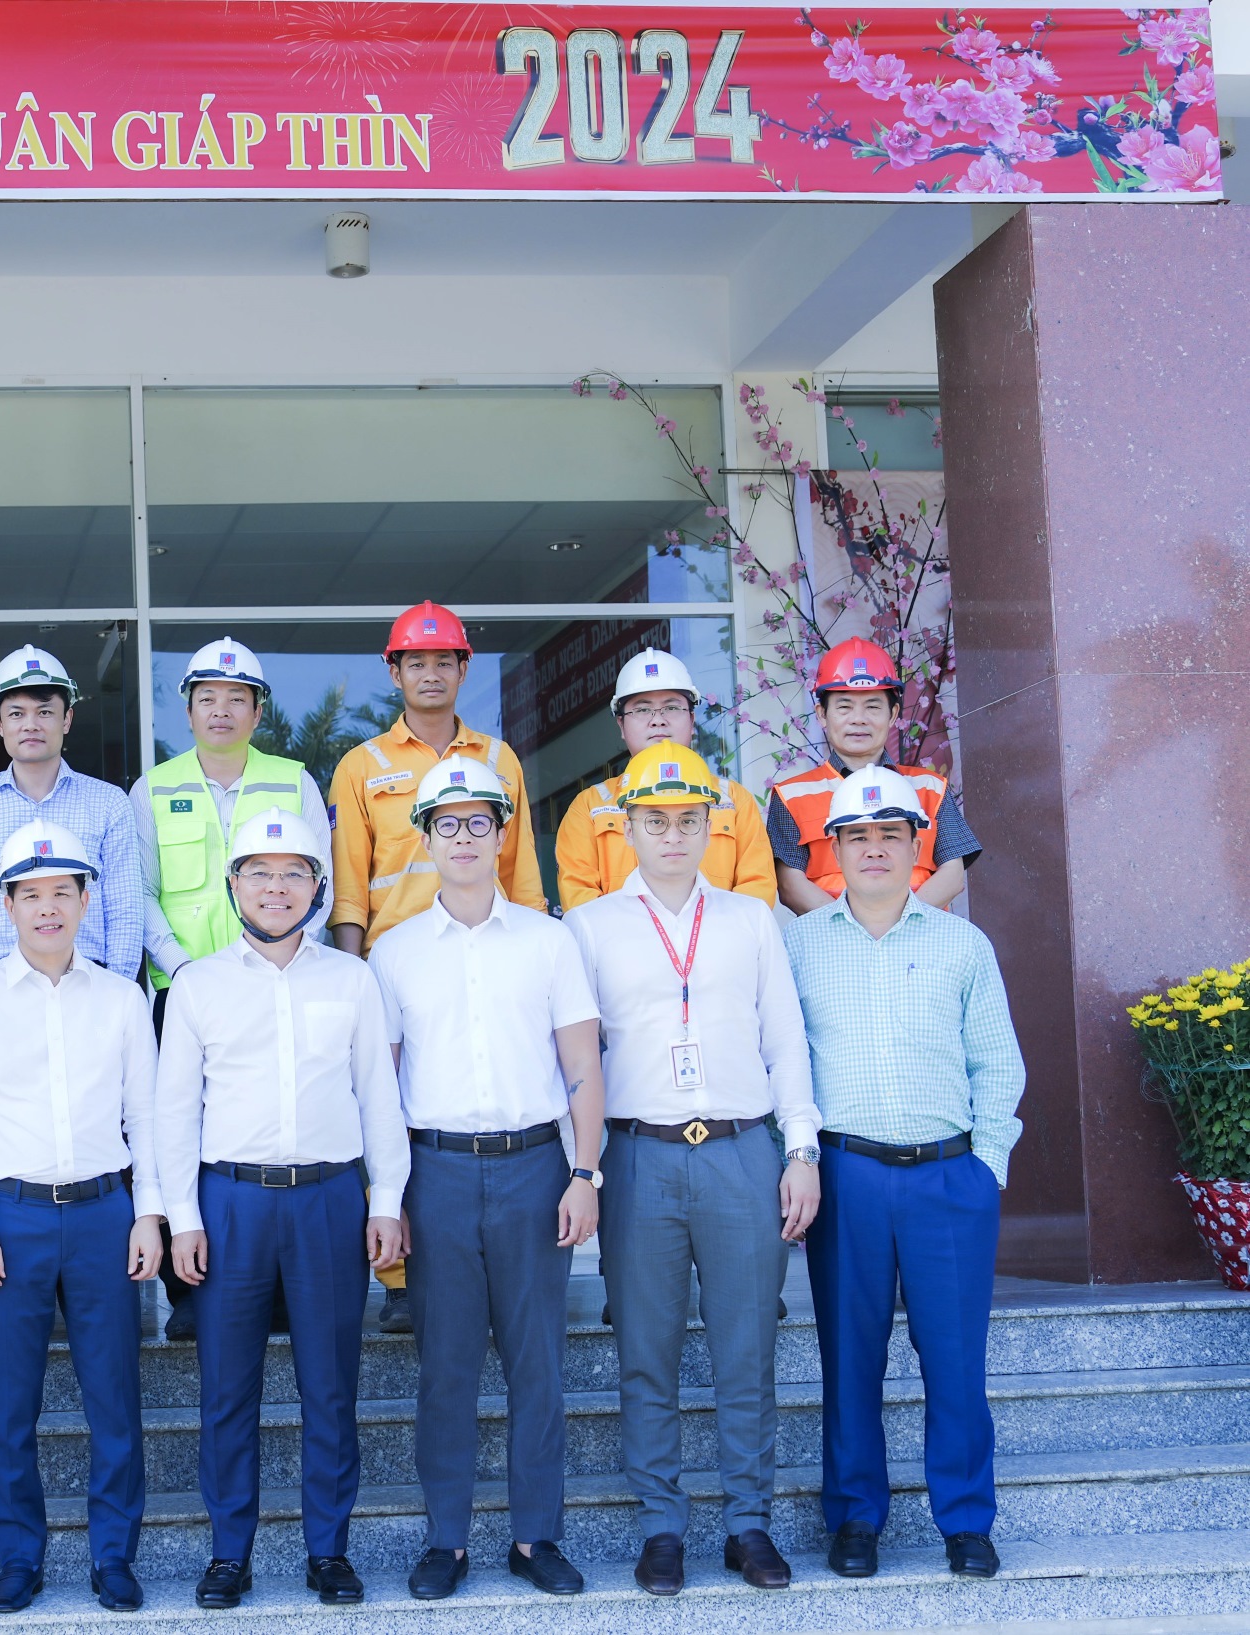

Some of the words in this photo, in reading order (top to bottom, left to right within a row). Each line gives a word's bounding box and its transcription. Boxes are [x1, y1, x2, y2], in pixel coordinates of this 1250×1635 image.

[112, 93, 267, 172] GIÁP
[277, 94, 433, 173] THÌN
[495, 26, 763, 171] 2024
